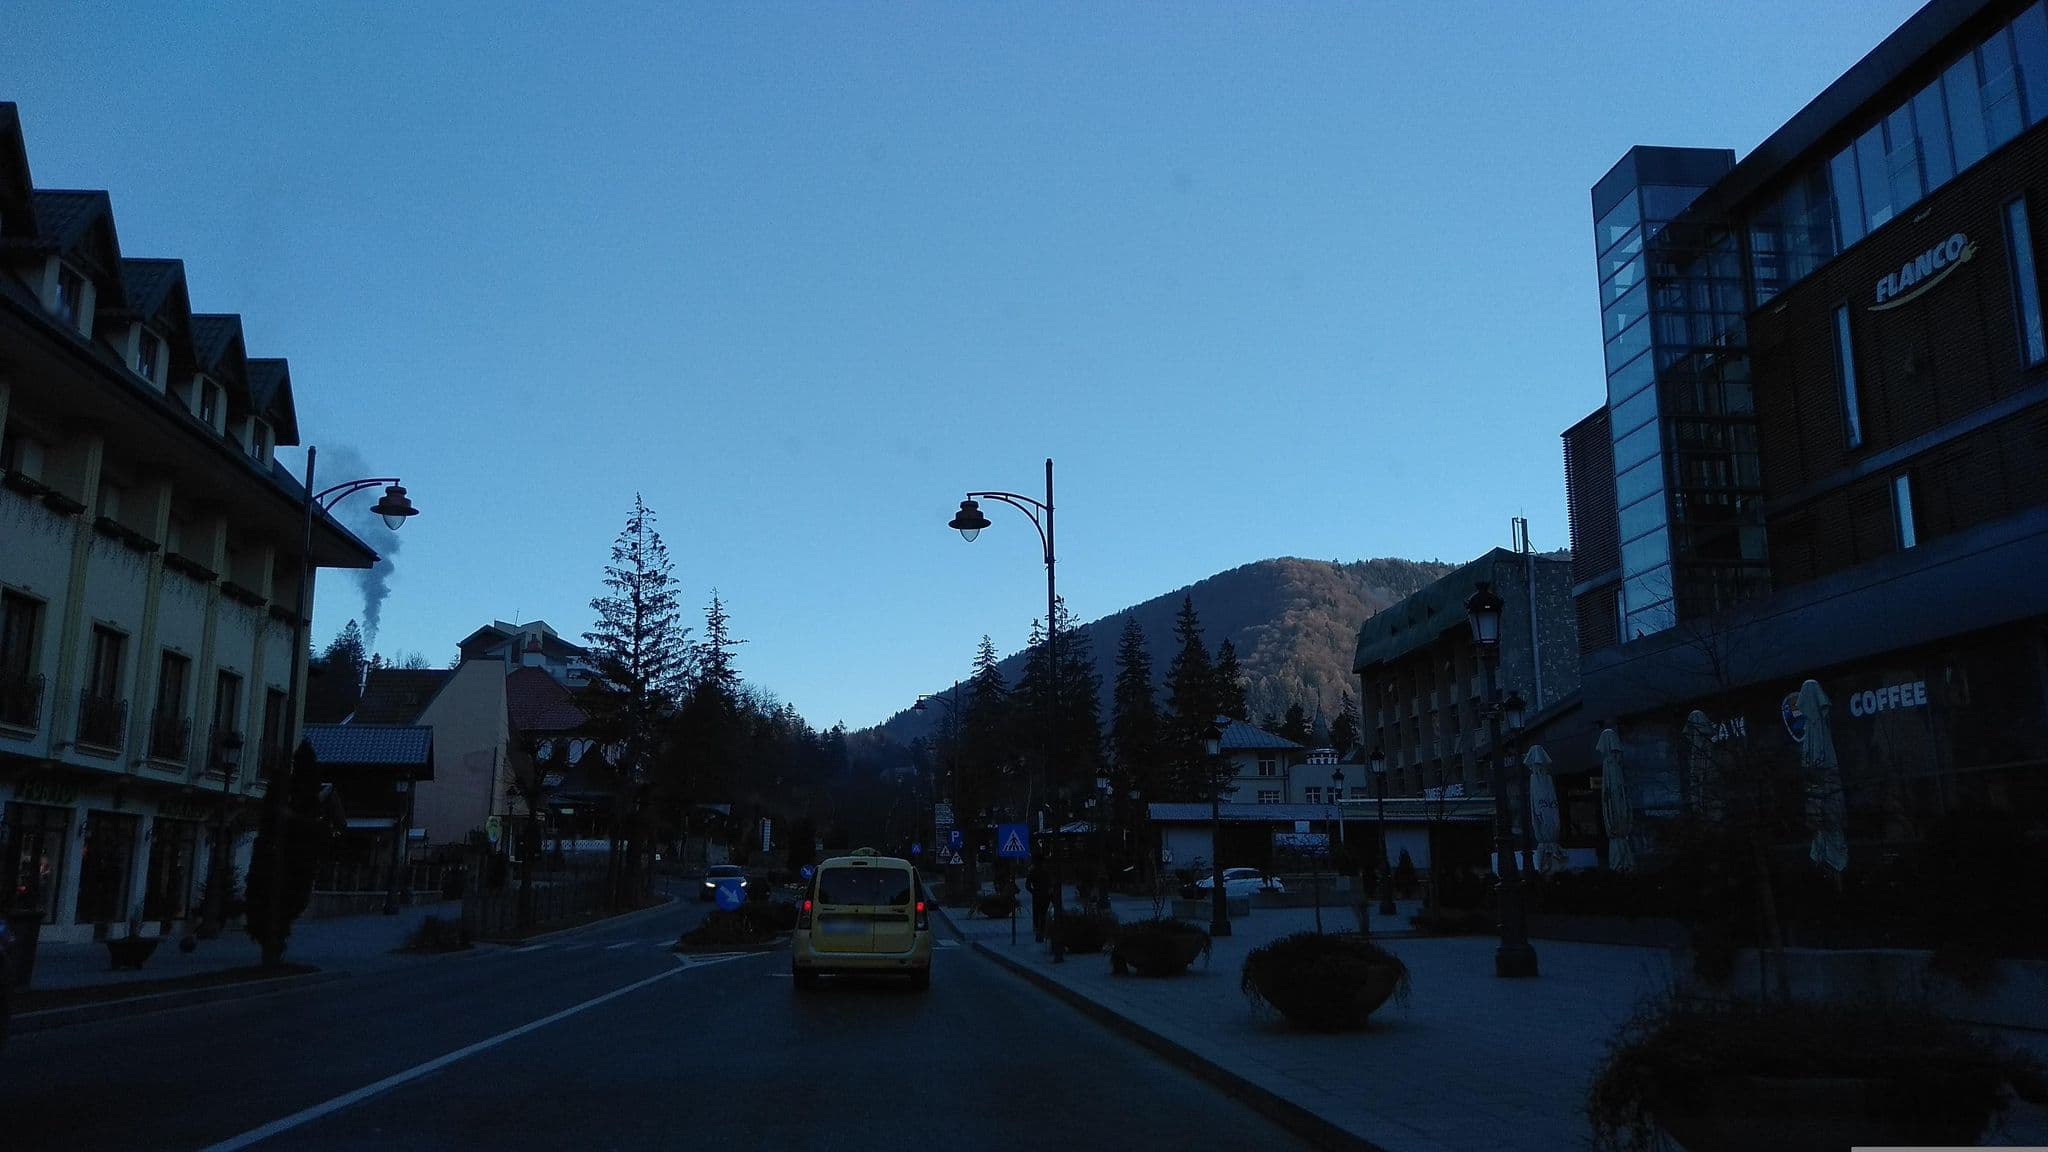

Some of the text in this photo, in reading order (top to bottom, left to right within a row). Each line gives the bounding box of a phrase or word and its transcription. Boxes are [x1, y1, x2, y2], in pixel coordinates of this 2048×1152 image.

[1876, 233, 1967, 302] FLANCO
[1850, 681, 1927, 717] COFFEE
[951, 830, 960, 843] P
